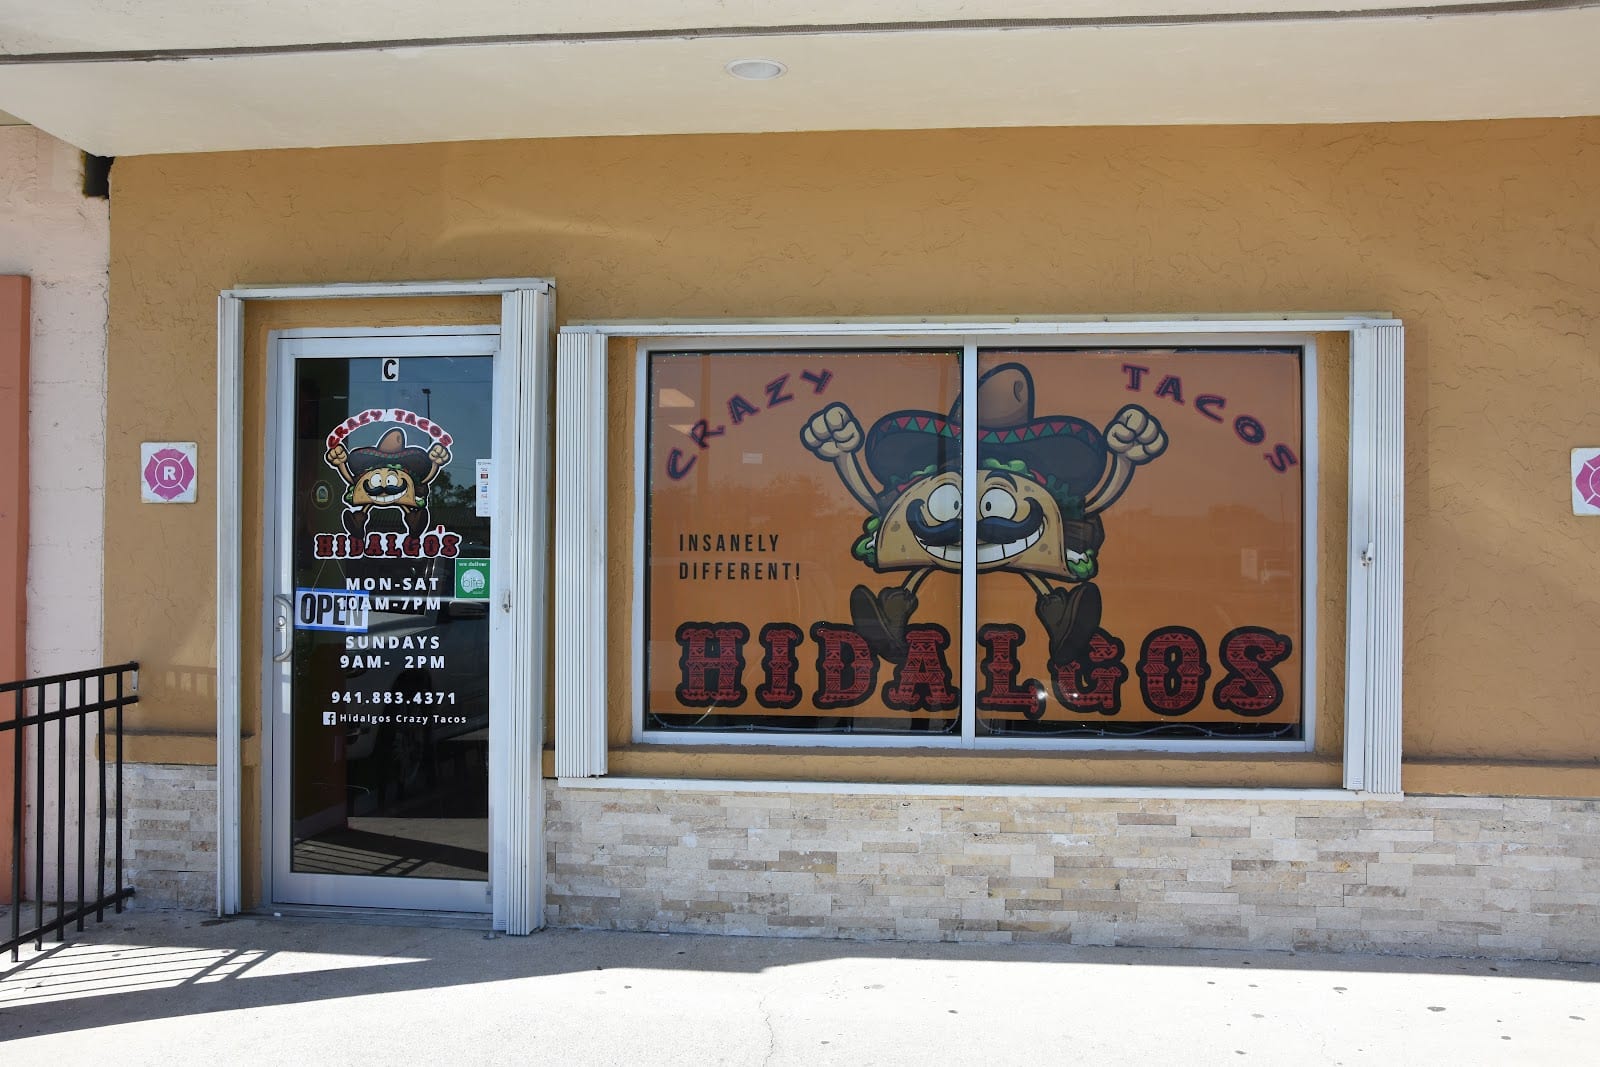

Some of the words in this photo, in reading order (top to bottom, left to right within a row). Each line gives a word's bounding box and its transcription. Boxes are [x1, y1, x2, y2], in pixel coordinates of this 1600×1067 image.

[383, 359, 397, 379] C
[327, 409, 383, 449] CRAZY
[394, 409, 453, 447] TACOS
[665, 368, 834, 482] CRAZY
[1121, 363, 1299, 474] TACOS
[163, 465, 177, 481] R
[315, 525, 461, 558] HIDALGO'S
[678, 534, 779, 552] INSANELY
[678, 562, 801, 580] DIFFERENT!
[346, 577, 439, 590] MON-SAT
[462, 575, 483, 588] bite
[300, 593, 363, 627] OPEN
[337, 597, 441, 611] 10AM-7PM
[345, 635, 441, 650] SUNDAYS
[404, 655, 446, 669] 2PM
[675, 621, 1292, 719] HIDALGOS
[331, 692, 455, 704] 941.883.4371
[339, 713, 392, 725] Hidalgos
[395, 714, 429, 726] Crazy
[432, 714, 468, 724] Tacos
